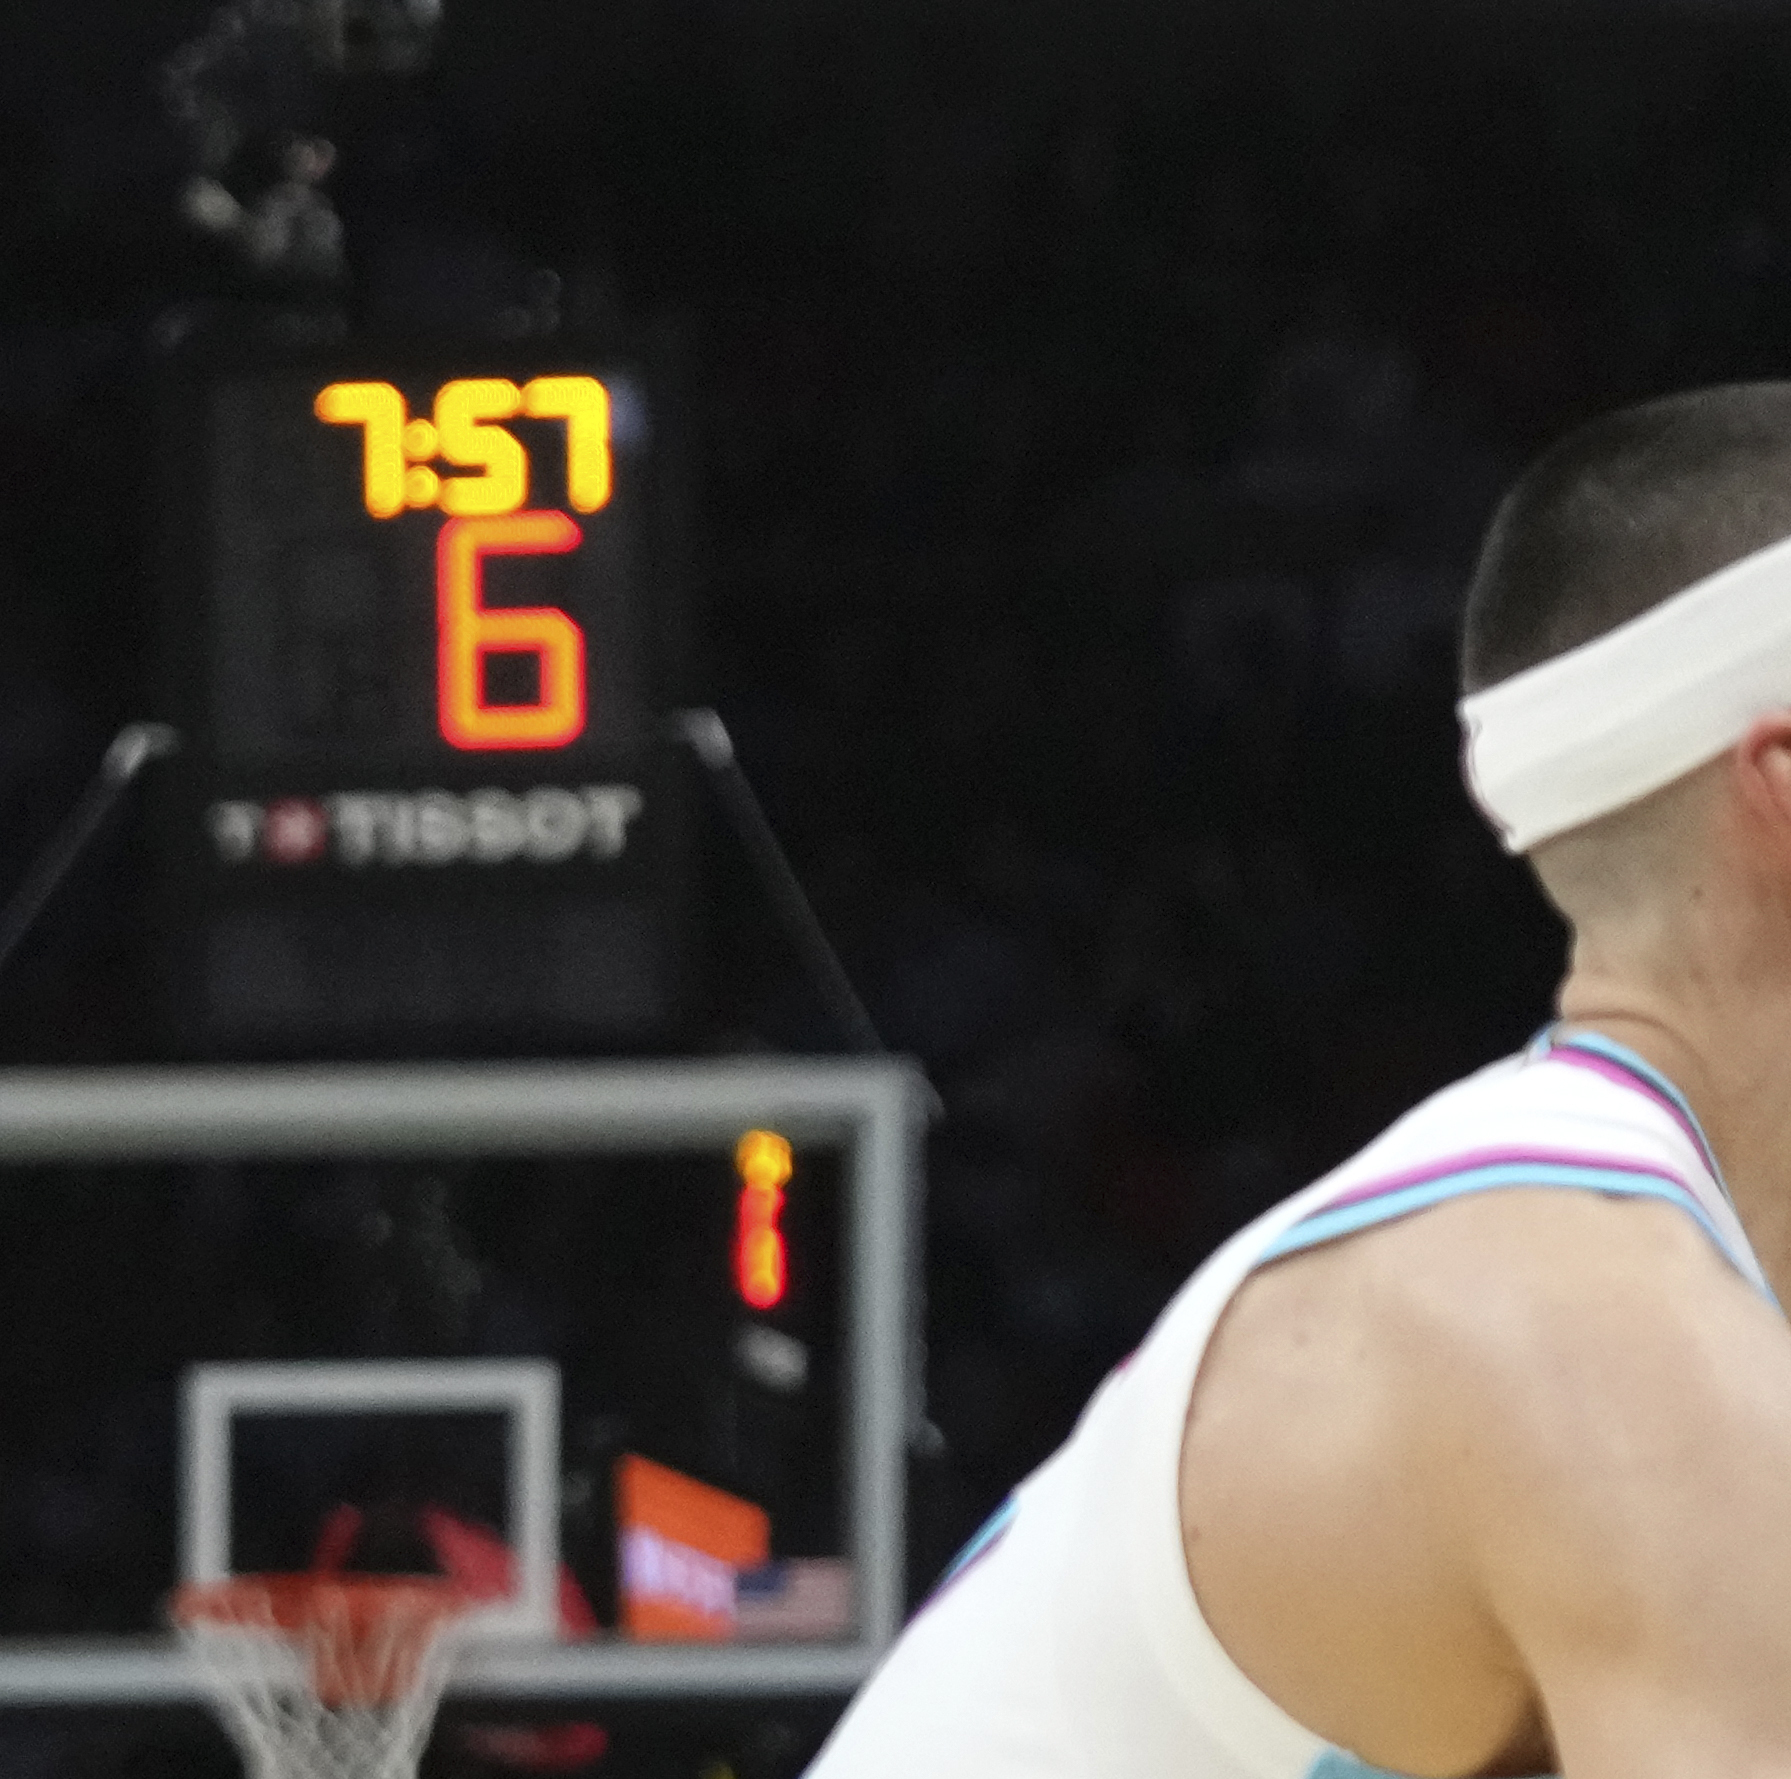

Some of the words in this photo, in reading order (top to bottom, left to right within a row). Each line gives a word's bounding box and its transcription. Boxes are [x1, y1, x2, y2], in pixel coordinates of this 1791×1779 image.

[314, 376, 610, 518] 7:57
[437, 510, 586, 749] 6
[328, 785, 642, 865] TISSOT
